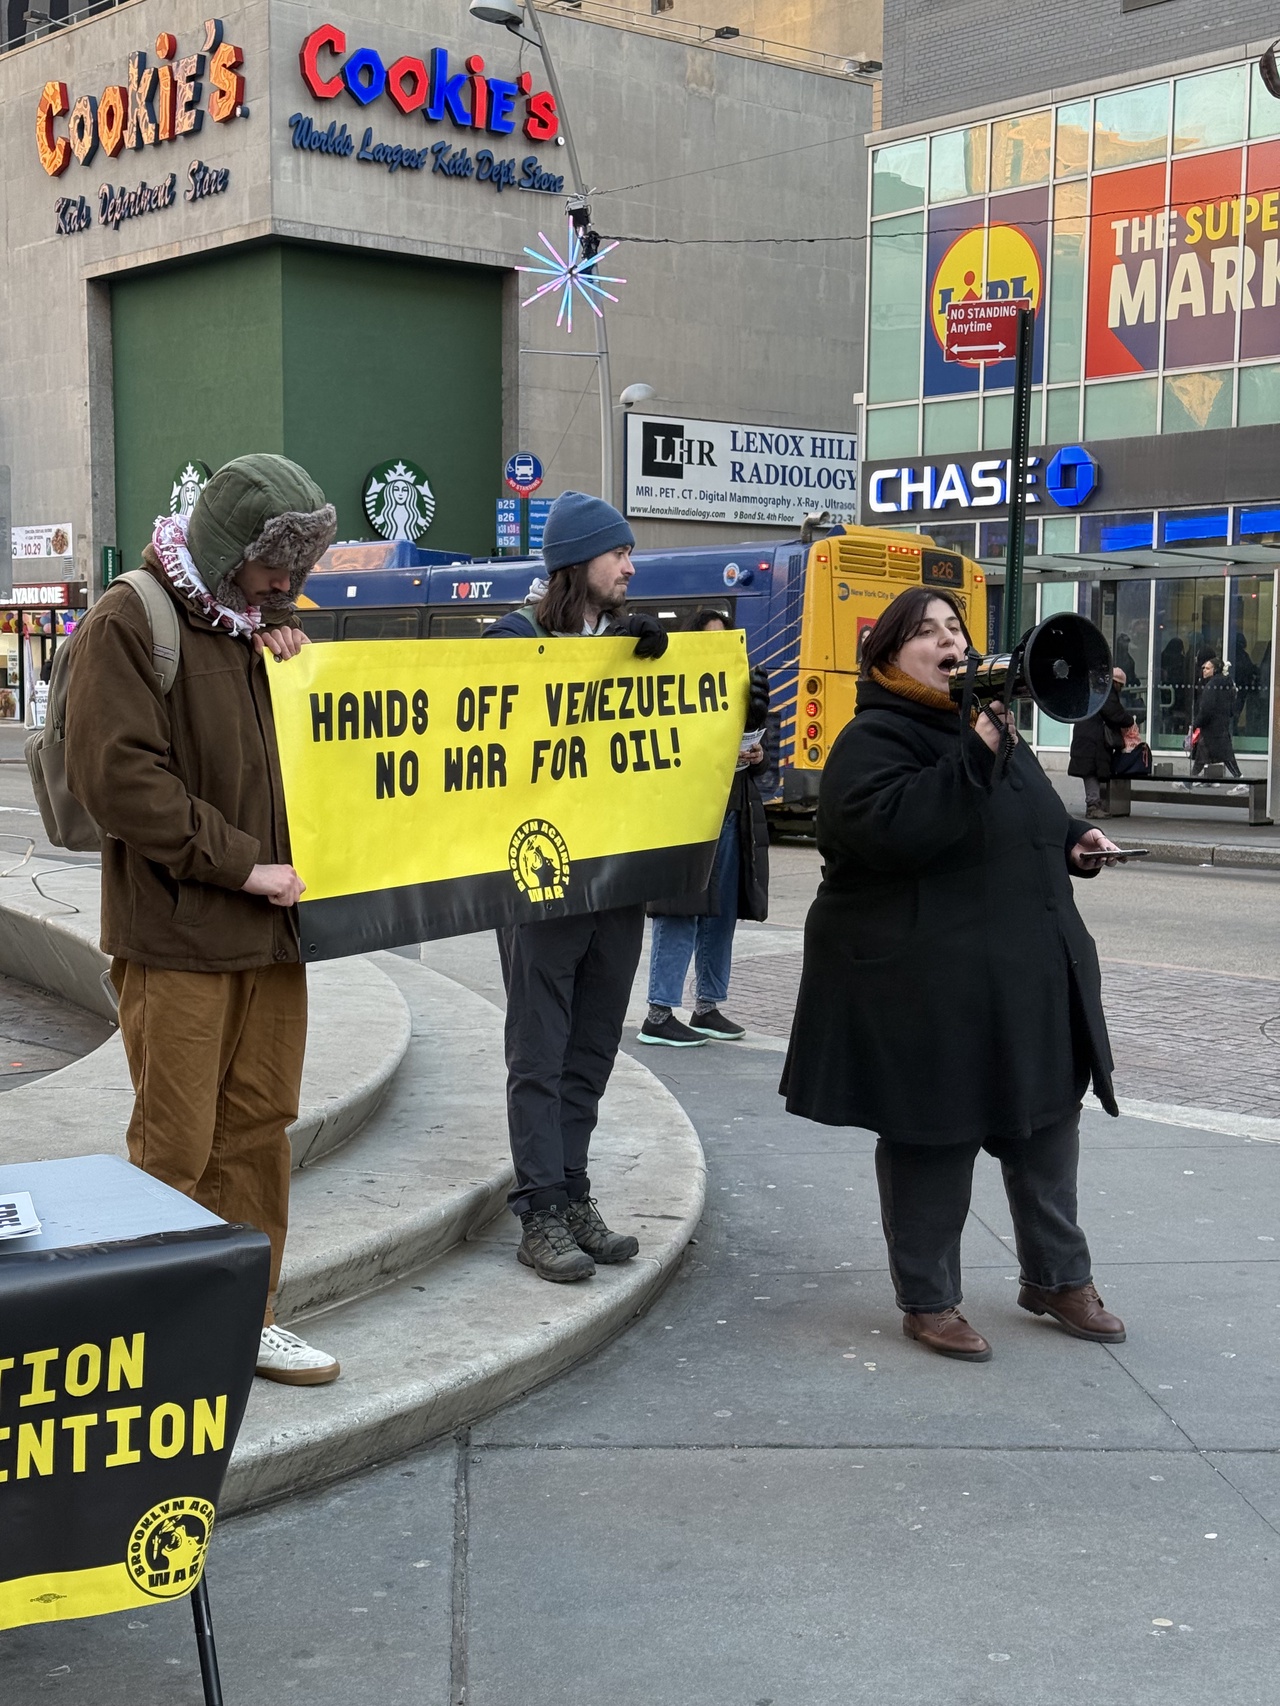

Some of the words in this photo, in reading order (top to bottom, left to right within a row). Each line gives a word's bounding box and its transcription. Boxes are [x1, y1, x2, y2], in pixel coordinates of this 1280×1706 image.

[289, 112, 355, 157] Worlds
[357, 127, 428, 173] Largest
[431, 140, 475, 177] Kids
[518, 156, 564, 192] Store
[55, 195, 91, 235] Kids
[98, 173, 176, 231] Department
[184, 159, 230, 203] Store
[1110, 210, 1178, 256] THE
[950, 308, 965, 320] NO
[967, 306, 1017, 319] STANDING
[950, 321, 993, 335] Anytime
[653, 435, 718, 467] LHR
[730, 430, 805, 457] LENOX
[730, 461, 857, 490] RADIOLOGY
[869, 457, 1040, 513] CHASE
[498, 499, 516, 509] B25
[636, 486, 653, 497] MRI
[659, 487, 675, 498] PET
[681, 489, 693, 500] CT
[699, 490, 727, 503] Digital
[729, 492, 791, 508] Mammography
[797, 497, 819, 510] X-Ray
[498, 513, 515, 522] B26
[630, 505, 726, 519] www.lenoxhillradiology.com
[733, 511, 739, 519] 9
[739, 511, 756, 520] Bond
[766, 512, 778, 521] 4th
[779, 513, 794, 522] Floor
[498, 537, 515, 546] B52
[40, 586, 64, 604] ONE
[309, 688, 429, 743] HANDS
[456, 684, 520, 733] OFF
[545, 671, 729, 727] VENEZUELA!
[376, 750, 419, 800] NO
[444, 743, 507, 793] WAR
[531, 735, 588, 784] FOR
[610, 727, 682, 774] OIL!
[509, 821, 539, 893] BROOKLYN
[540, 822, 570, 886] AGAINST
[527, 884, 565, 903] WAR
[130, 1500, 185, 1578] BROOKLYN
[147, 1562, 200, 1588] WAR
